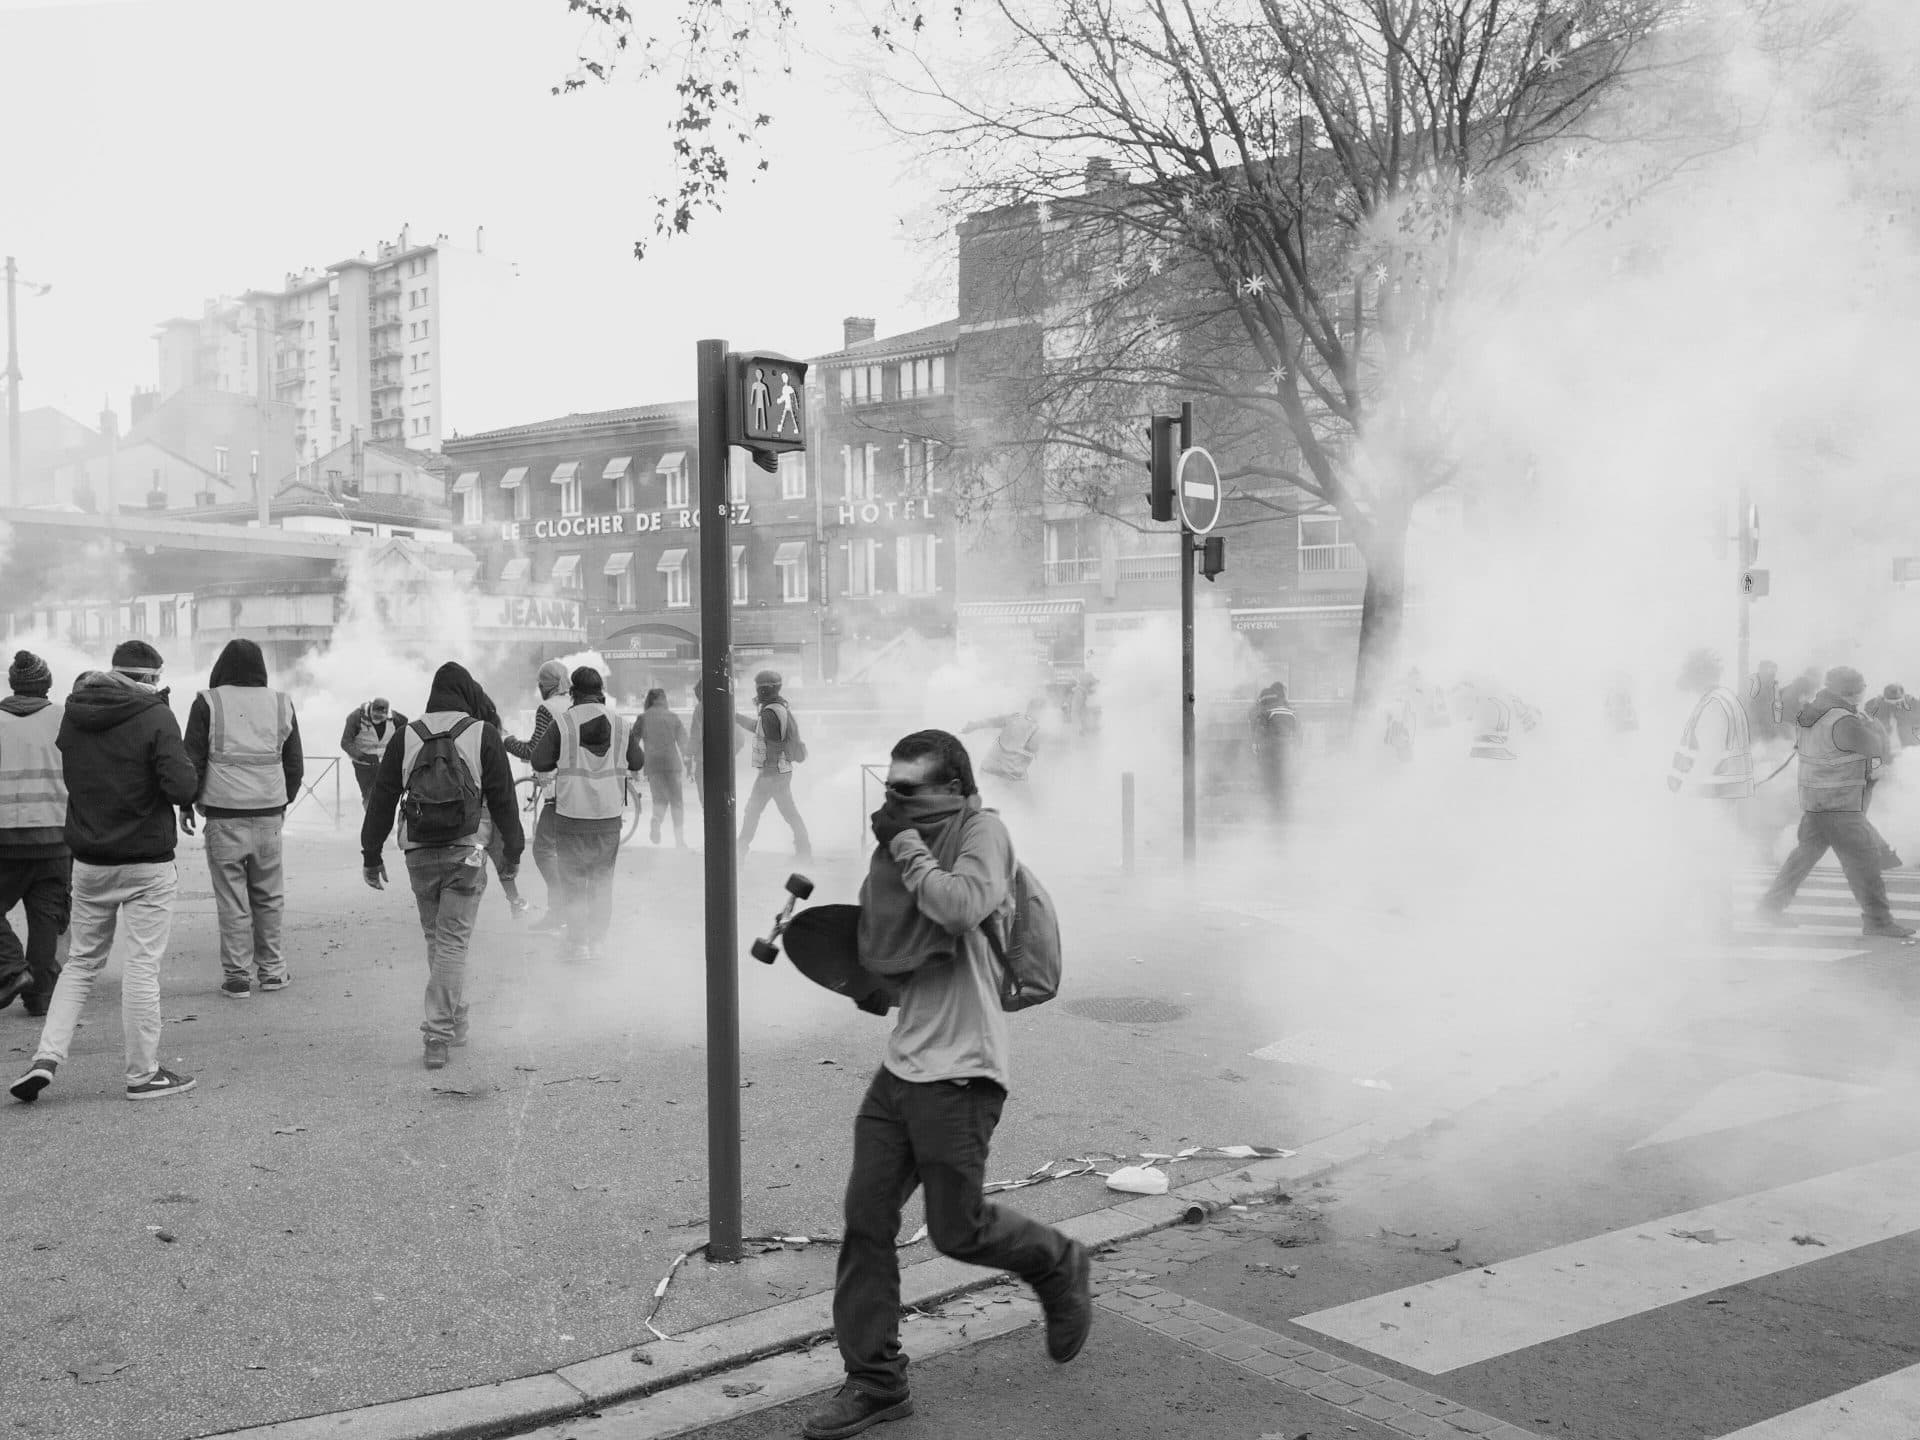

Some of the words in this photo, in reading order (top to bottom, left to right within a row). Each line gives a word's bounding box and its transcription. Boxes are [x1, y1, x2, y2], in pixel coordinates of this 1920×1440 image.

[718, 504, 726, 516] 8
[838, 499, 935, 525] HOTEL
[502, 524, 520, 540] LE
[535, 514, 624, 538] CLOCHER
[636, 511, 661, 532] DE
[1236, 621, 1280, 630] CRYSTAL
